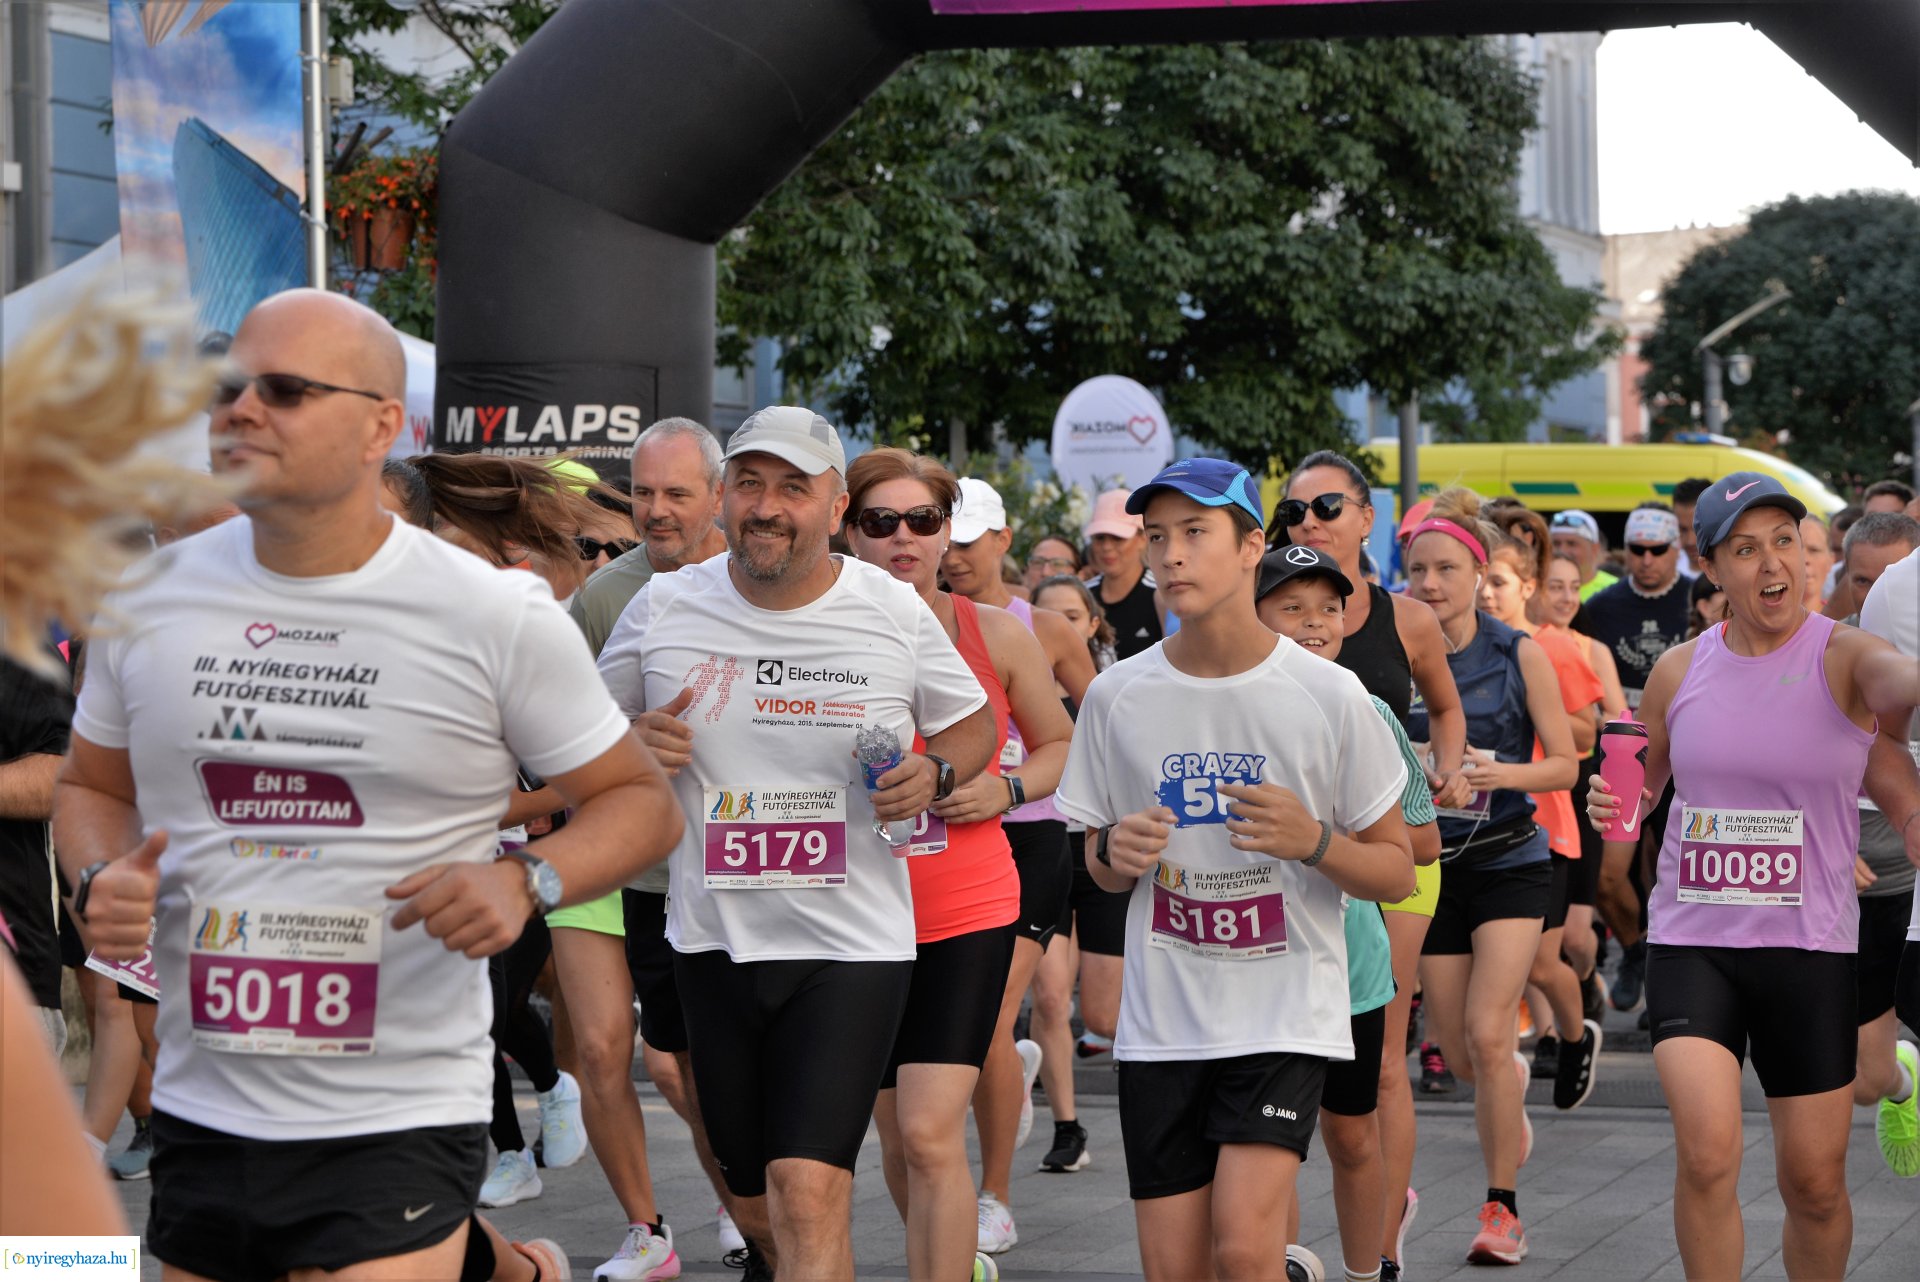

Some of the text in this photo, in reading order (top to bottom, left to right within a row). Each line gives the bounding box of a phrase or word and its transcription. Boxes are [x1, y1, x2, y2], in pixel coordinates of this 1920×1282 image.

[445, 404, 642, 444] MYLAPS
[277, 629, 340, 643] MOZAIK
[193, 656, 380, 686] III. NYÍREGYHÁZI
[788, 666, 869, 687] Electrolux
[192, 679, 371, 710] FUTÓFESZTIVÁL
[754, 698, 866, 715] VIDOR Jótékonysági
[822, 709, 866, 718] Félmaraton
[1162, 752, 1266, 780] CRAZY
[254, 770, 308, 793] ÉN IS
[220, 799, 352, 820] LEFUTOTTAM
[762, 800, 836, 811] FUTÓFESZTIVÁL
[1725, 822, 1793, 834] FUTÓFESZTIVÁL
[723, 830, 828, 867] 5179
[1684, 849, 1797, 886] 10089
[1195, 876, 1272, 891] FUTÓFESZTIVÁL
[1168, 896, 1261, 942] 5181
[258, 926, 368, 945] FUTÓFESZTIVÁL
[204, 966, 352, 1027] 5018
[1275, 1107, 1297, 1121] JAKO
